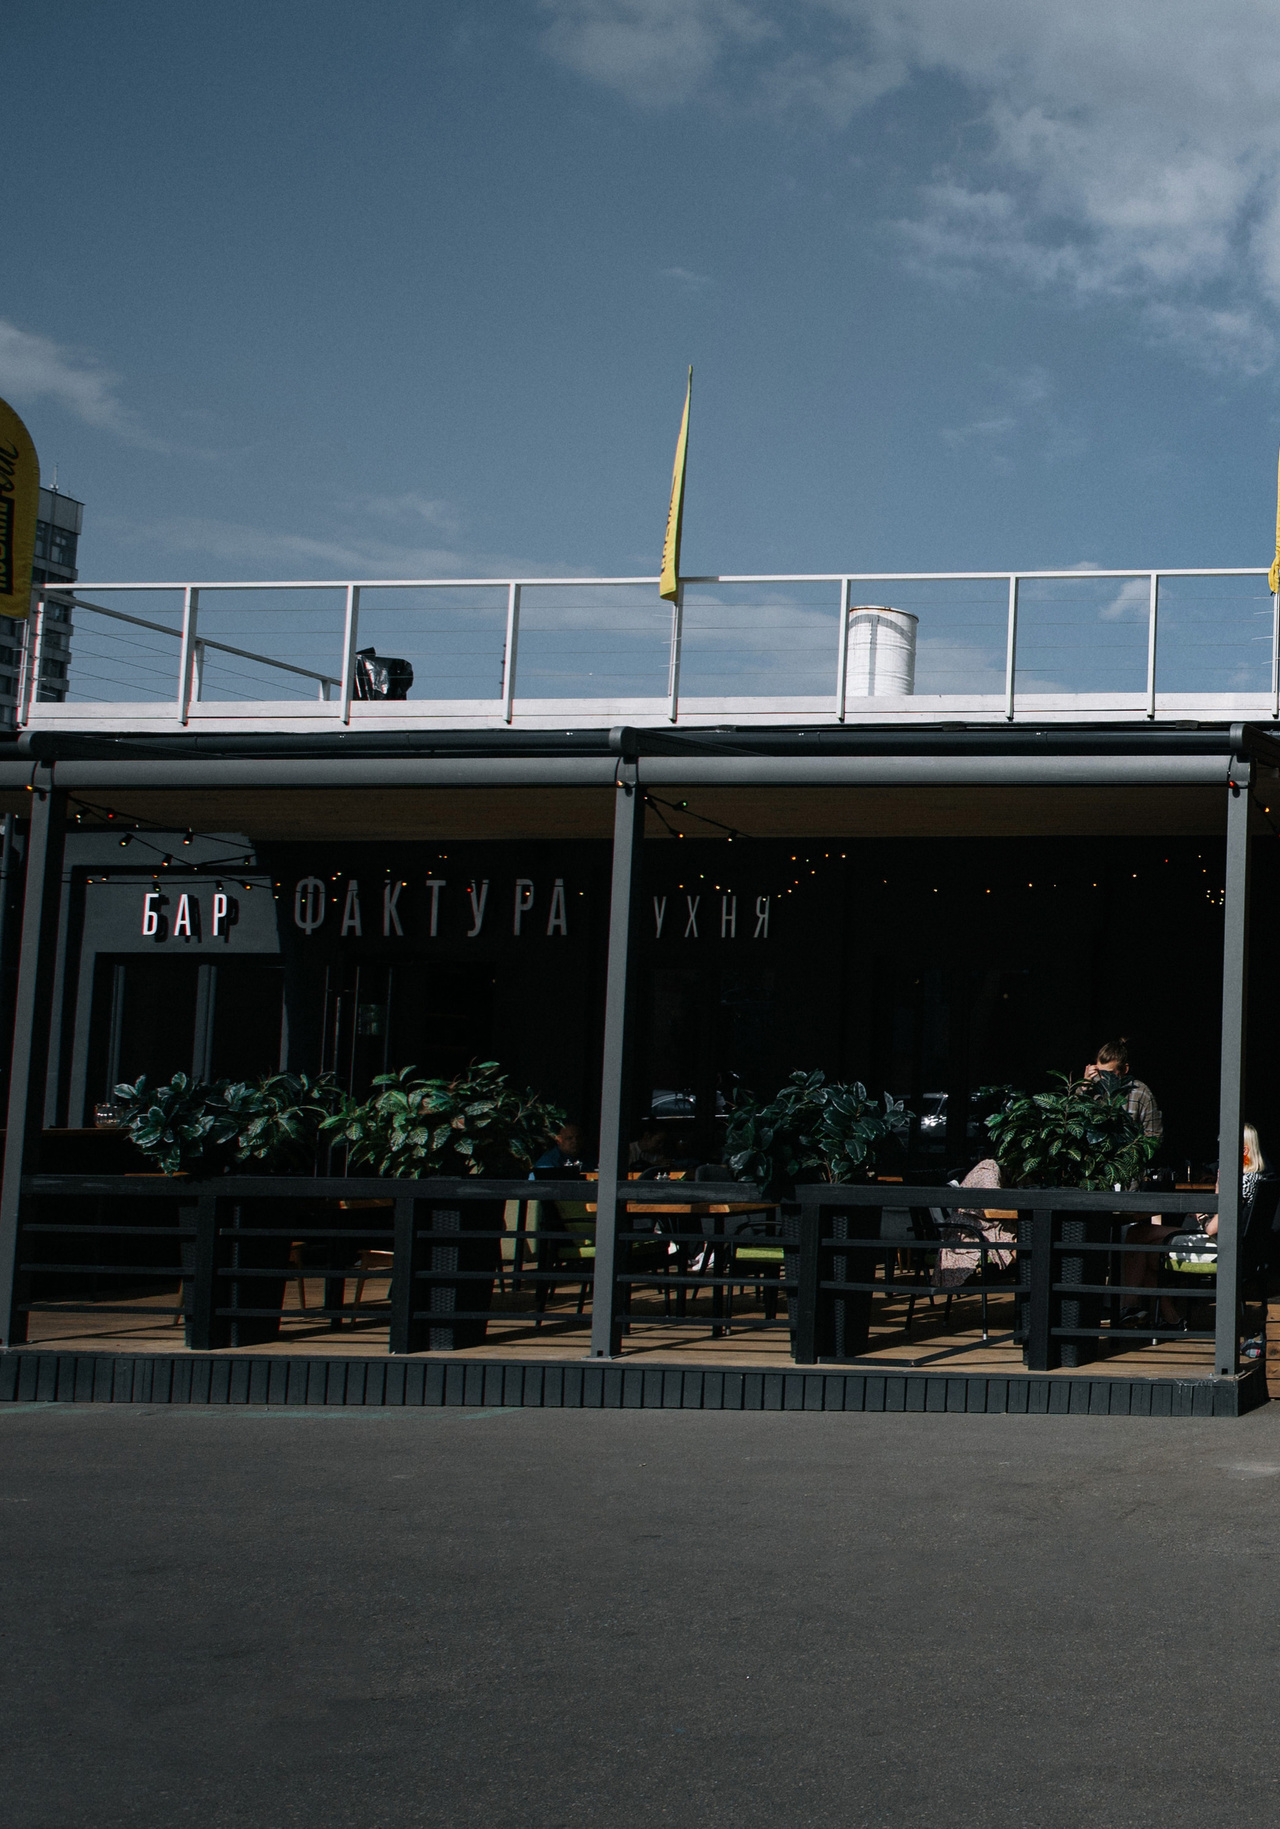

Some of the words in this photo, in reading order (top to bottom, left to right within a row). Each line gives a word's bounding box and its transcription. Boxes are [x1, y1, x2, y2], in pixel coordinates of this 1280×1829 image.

[141, 892, 229, 937] БАР
[293, 874, 568, 937] ФАКТУРА
[653, 894, 771, 939] УХНЯ
